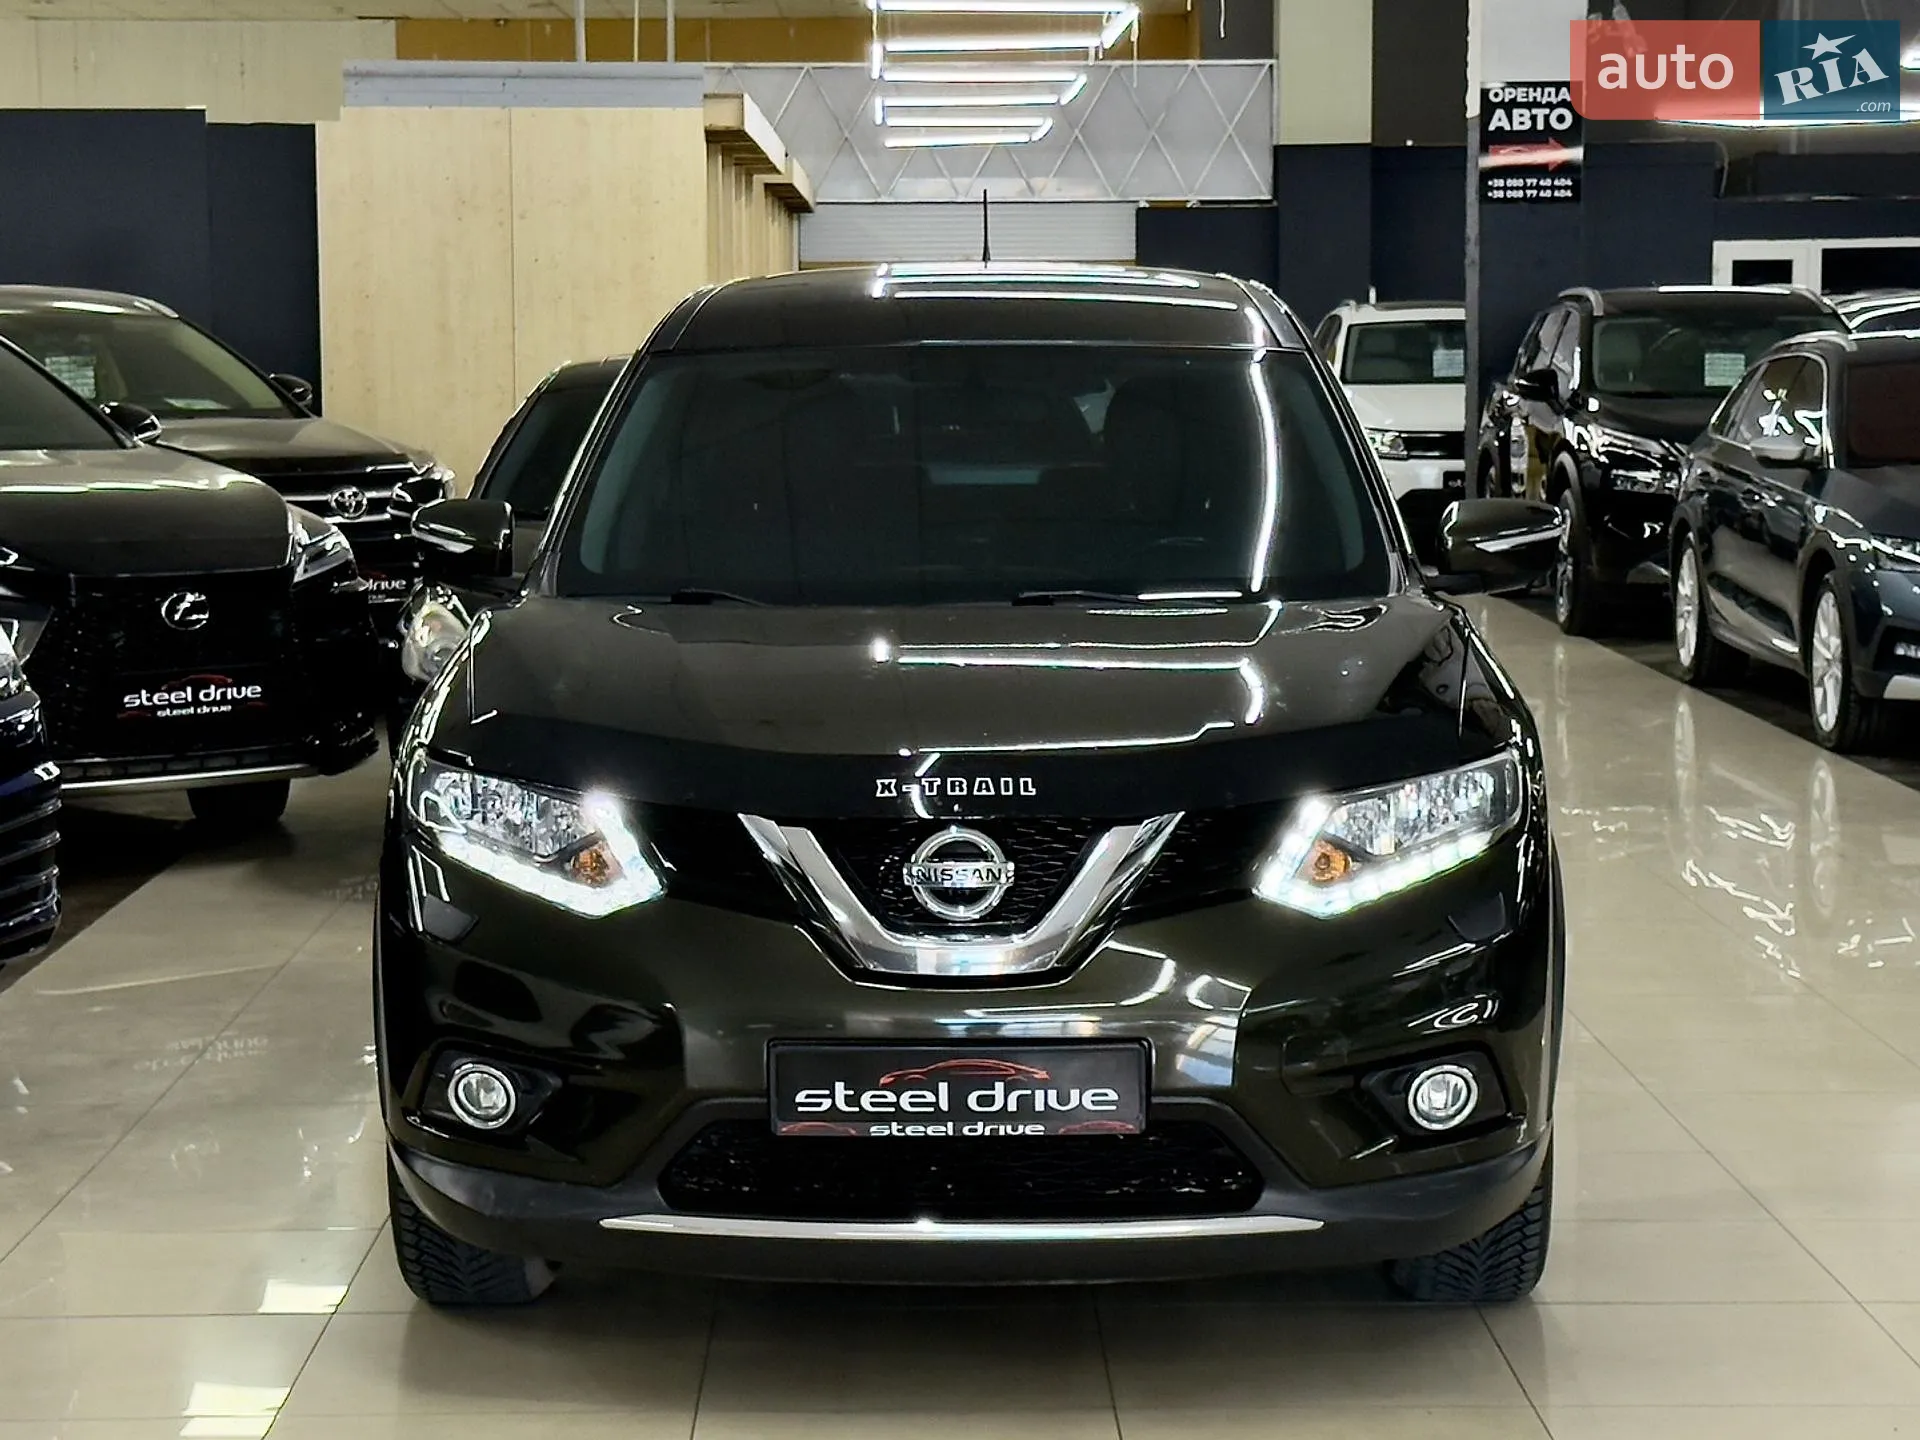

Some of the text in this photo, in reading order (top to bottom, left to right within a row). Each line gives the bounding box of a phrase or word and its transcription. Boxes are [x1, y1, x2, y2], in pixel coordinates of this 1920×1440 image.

[1488, 87, 1571, 104] ОРЕНДА
[1488, 107, 1573, 131] АВТО
[1525, 178, 1537, 187] 77
[1525, 189, 1537, 198] 77
[123, 684, 262, 708] steel drive
[156, 704, 232, 717] steel drive
[875, 777, 1037, 797] X-TRAIL
[915, 867, 1002, 882] NISSAN
[795, 1081, 1119, 1112] steel drive
[869, 1121, 1046, 1136] steel drive
